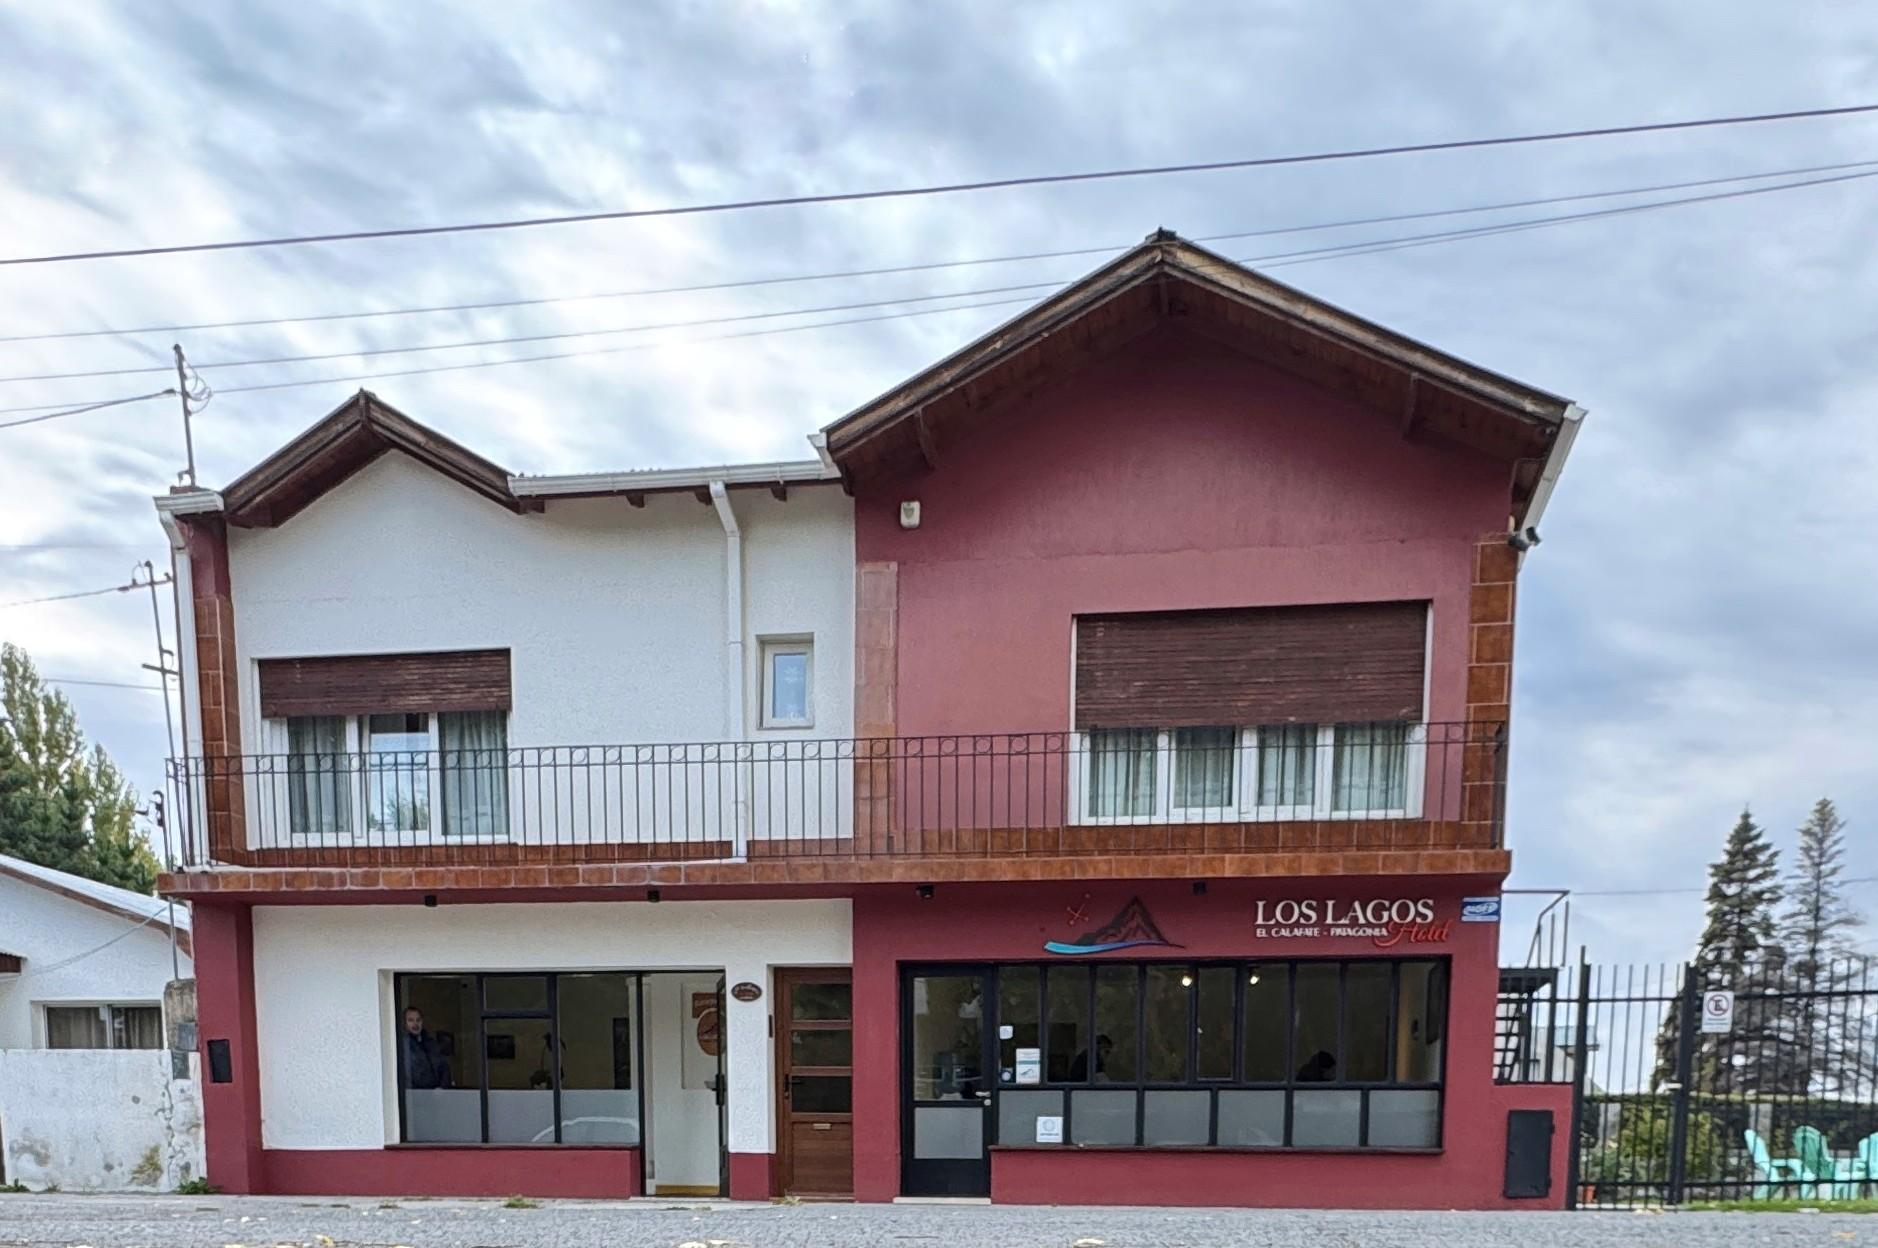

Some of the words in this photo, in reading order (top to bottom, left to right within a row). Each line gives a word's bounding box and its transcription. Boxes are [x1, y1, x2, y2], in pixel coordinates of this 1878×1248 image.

[1255, 900, 1318, 925] LOS
[1325, 899, 1434, 924] LAGOS
[1256, 927, 1269, 938] EL
[1271, 927, 1320, 938] CALAFATE
[1330, 927, 1388, 937] PATAGONIA
[1375, 920, 1449, 946] Hotel
